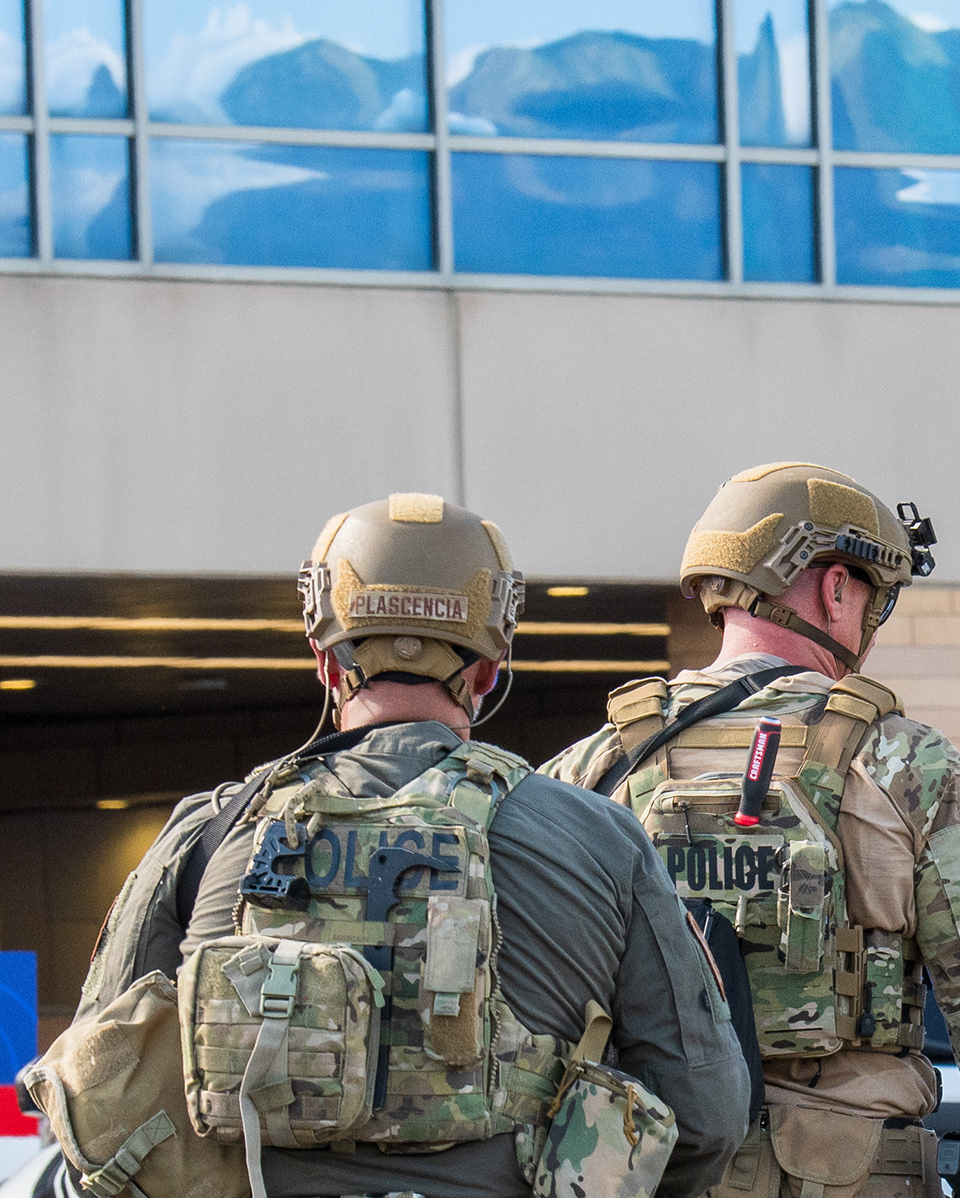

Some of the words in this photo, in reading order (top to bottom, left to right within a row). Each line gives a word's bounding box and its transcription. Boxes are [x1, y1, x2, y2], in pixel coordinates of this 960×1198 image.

[355, 594, 463, 620] PLASCENCIA
[749, 732, 767, 780] CRAFTSMAN
[667, 845, 775, 892] POLICE
